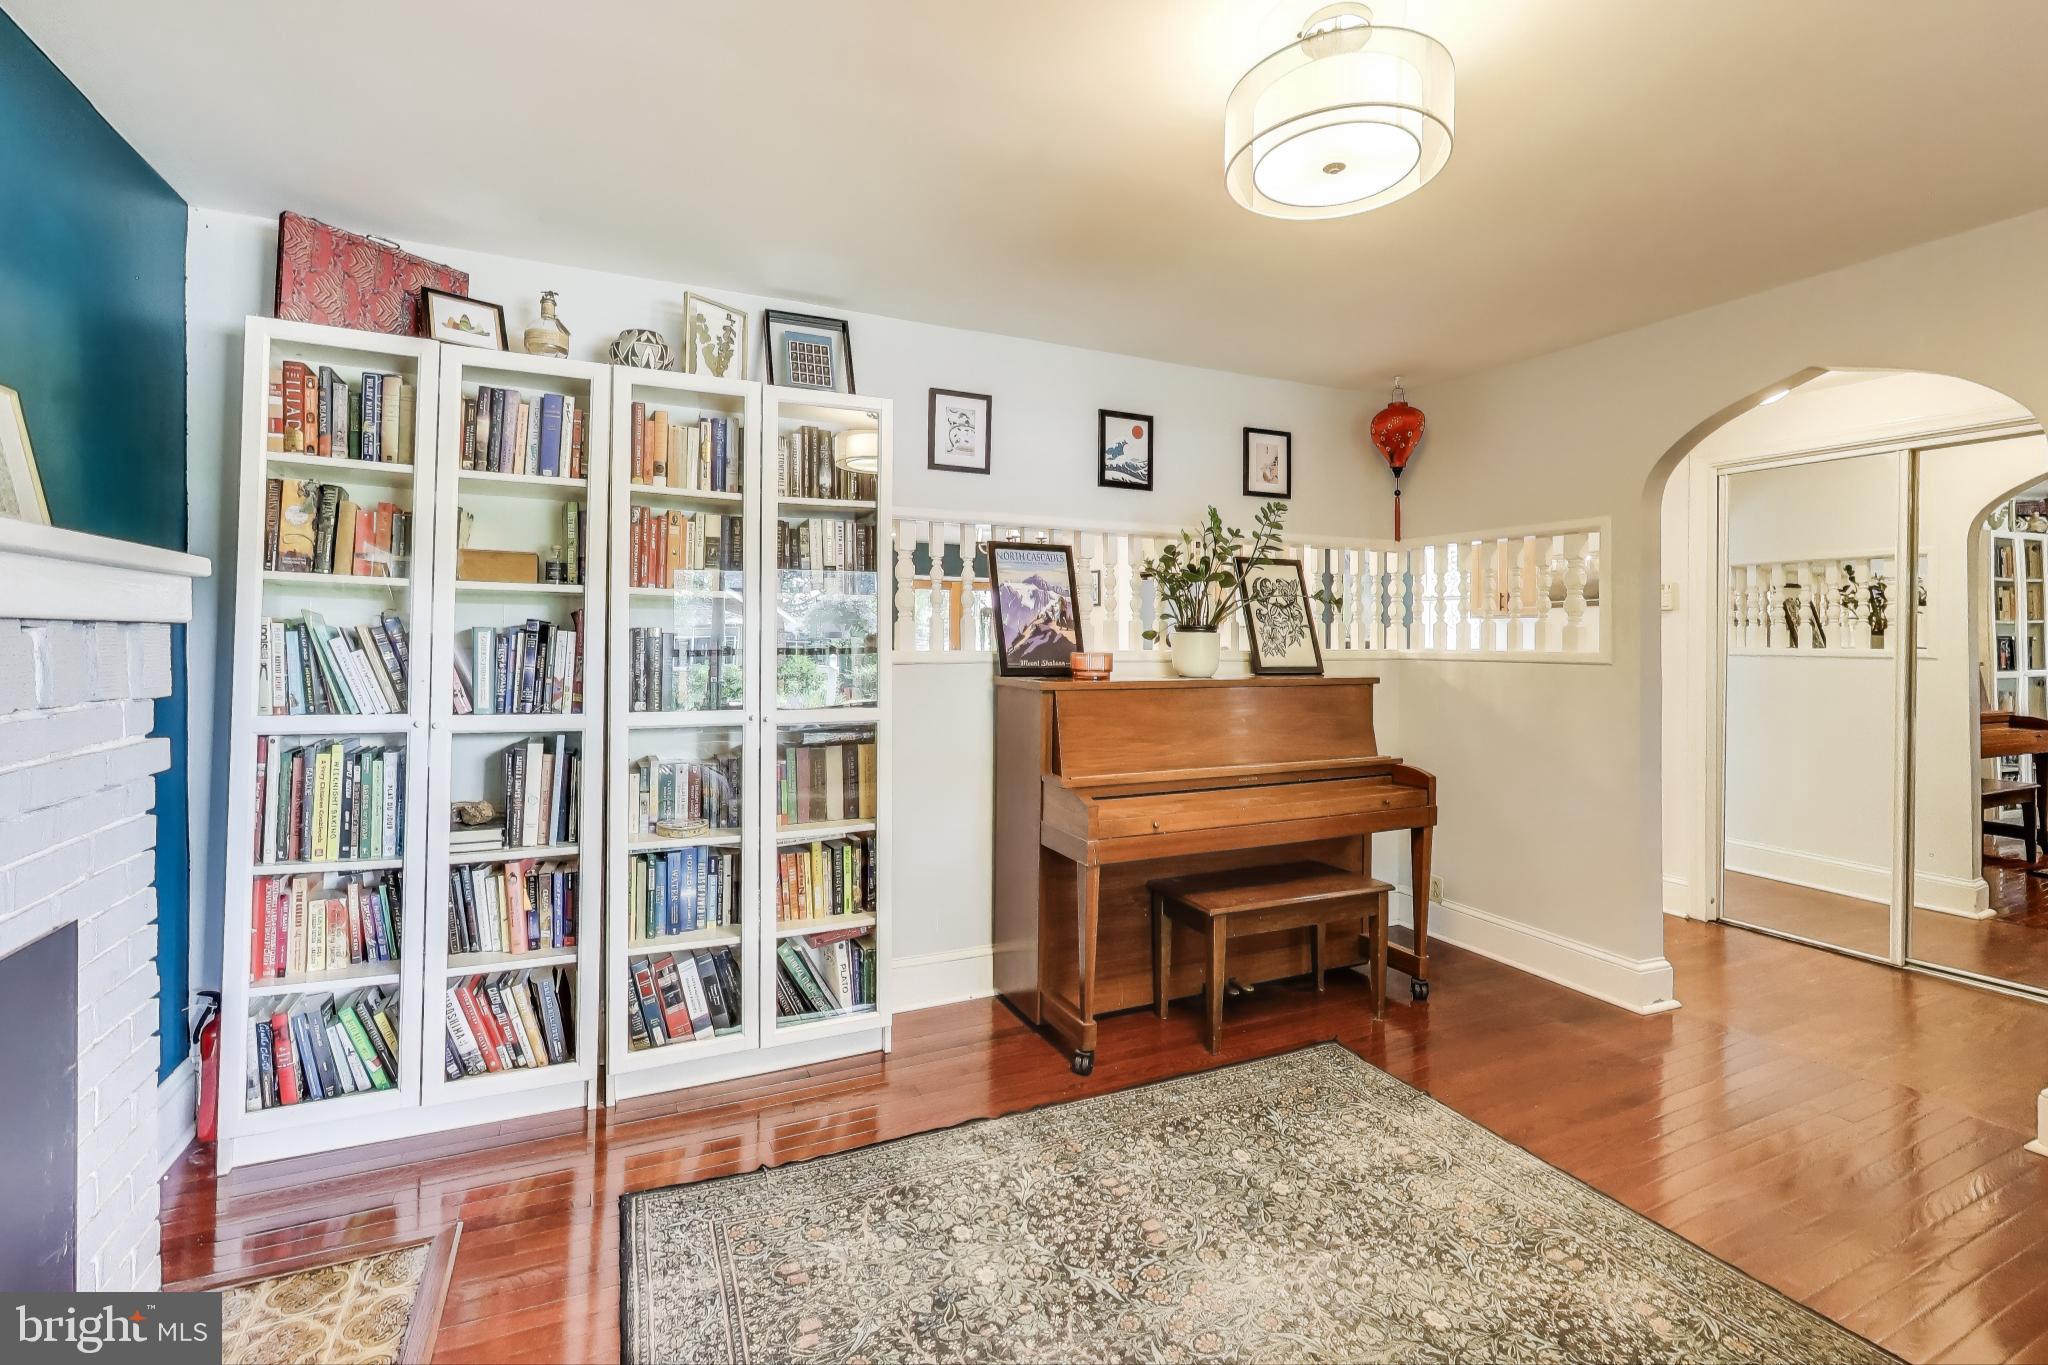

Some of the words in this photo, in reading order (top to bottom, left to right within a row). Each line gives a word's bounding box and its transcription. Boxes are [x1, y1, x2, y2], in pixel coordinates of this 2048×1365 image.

[286, 379, 302, 432] ILIAD
[997, 551, 1027, 561] NORTH
[1028, 553, 1064, 563] CASCADES
[387, 802, 393, 811] DU
[671, 869, 679, 902] WATER
[697, 893, 705, 913] POWER
[840, 963, 849, 994] PLATO
